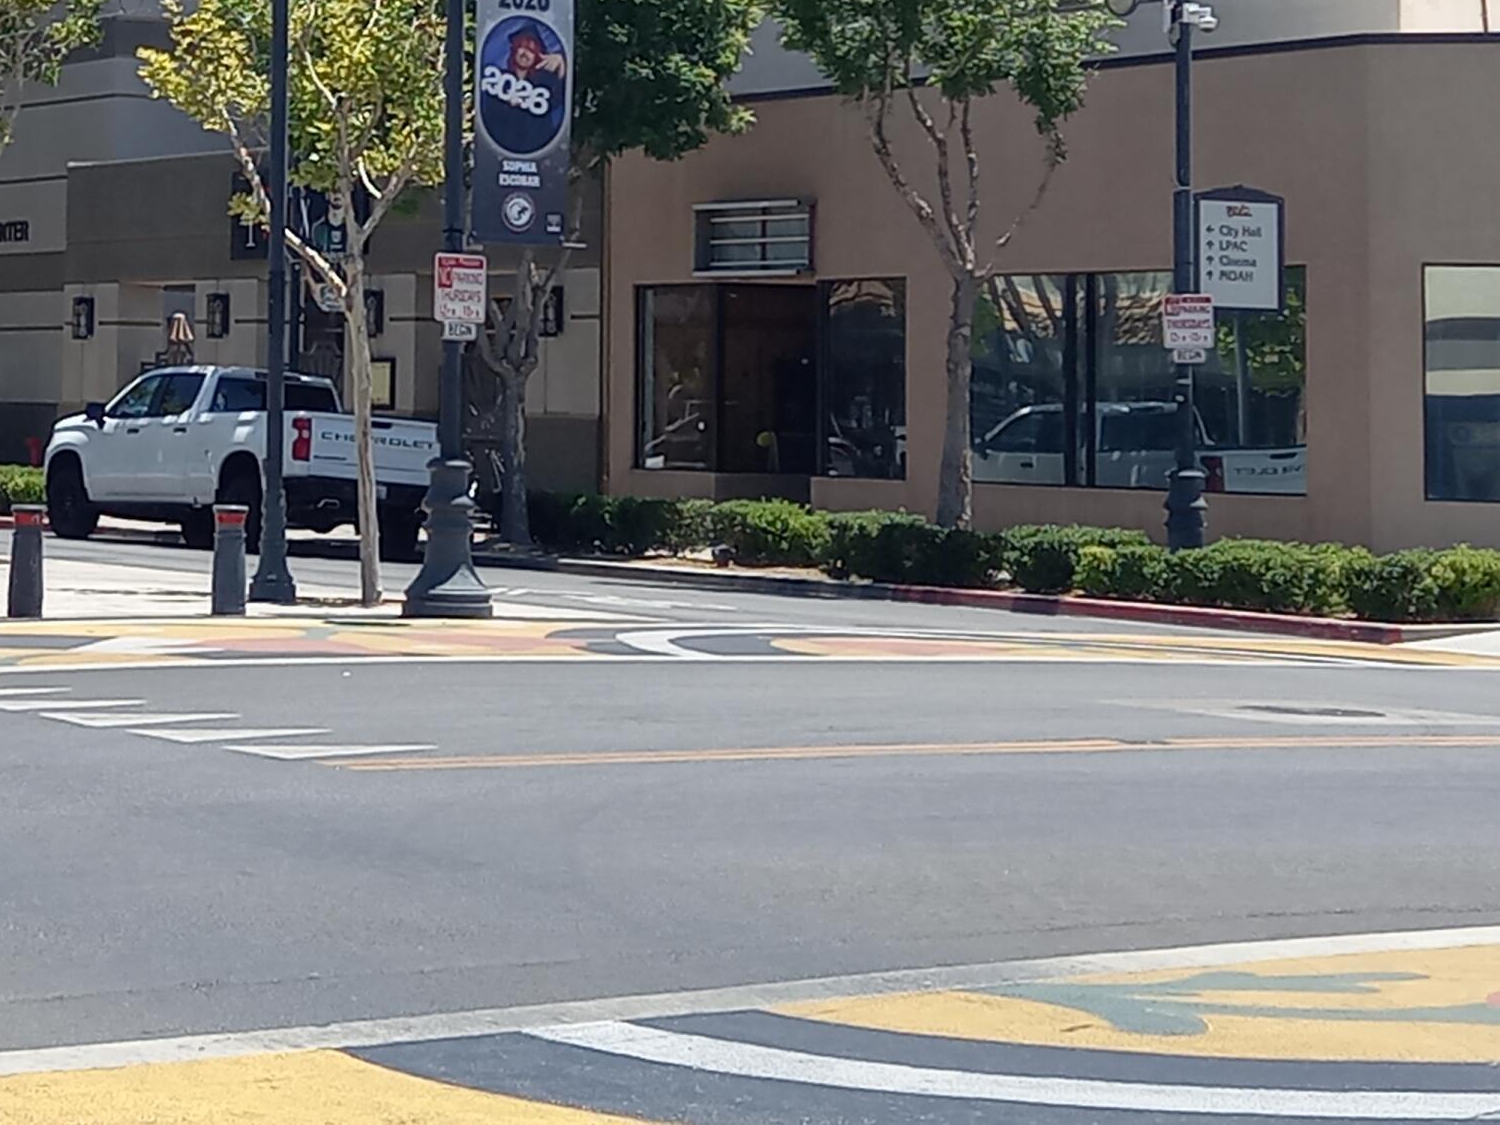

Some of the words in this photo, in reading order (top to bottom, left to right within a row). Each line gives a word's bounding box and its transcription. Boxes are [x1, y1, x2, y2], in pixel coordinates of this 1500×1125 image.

[482, 65, 550, 115] 2026
[1219, 224, 1238, 239] City
[1242, 225, 1262, 237] Hall
[1219, 240, 1248, 252] LPAC
[1219, 255, 1257, 267] Cinema
